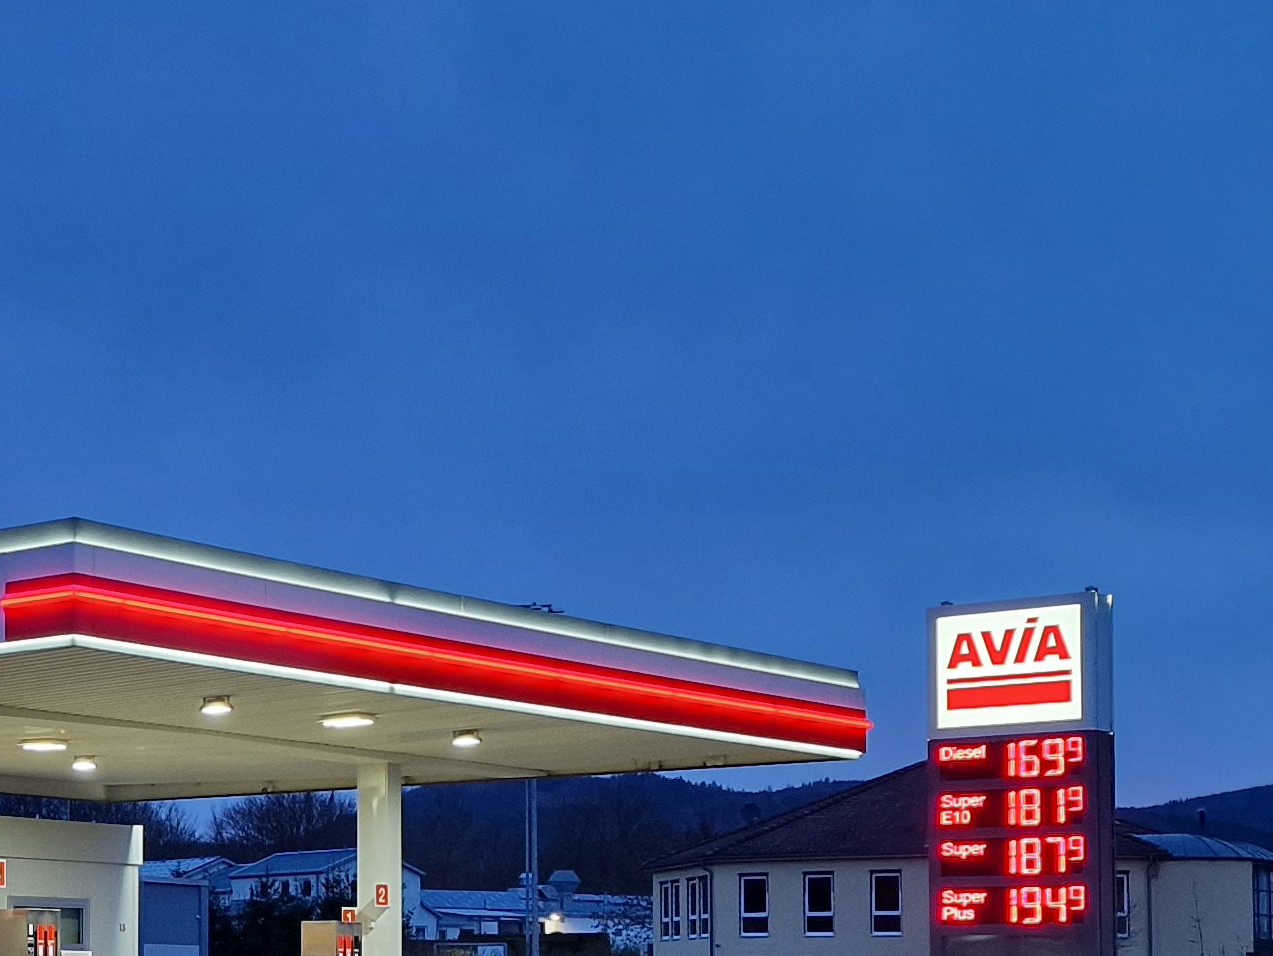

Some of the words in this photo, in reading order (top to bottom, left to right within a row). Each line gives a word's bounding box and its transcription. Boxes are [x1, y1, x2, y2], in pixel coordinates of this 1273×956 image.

[938, 744, 987, 762] Diesel
[940, 794, 987, 810] Super
[939, 810, 971, 826] E10
[941, 841, 987, 860] Super
[378, 887, 386, 903] 2
[941, 889, 988, 907] Super
[346, 911, 352, 923] 1
[941, 906, 976, 921] Plus
